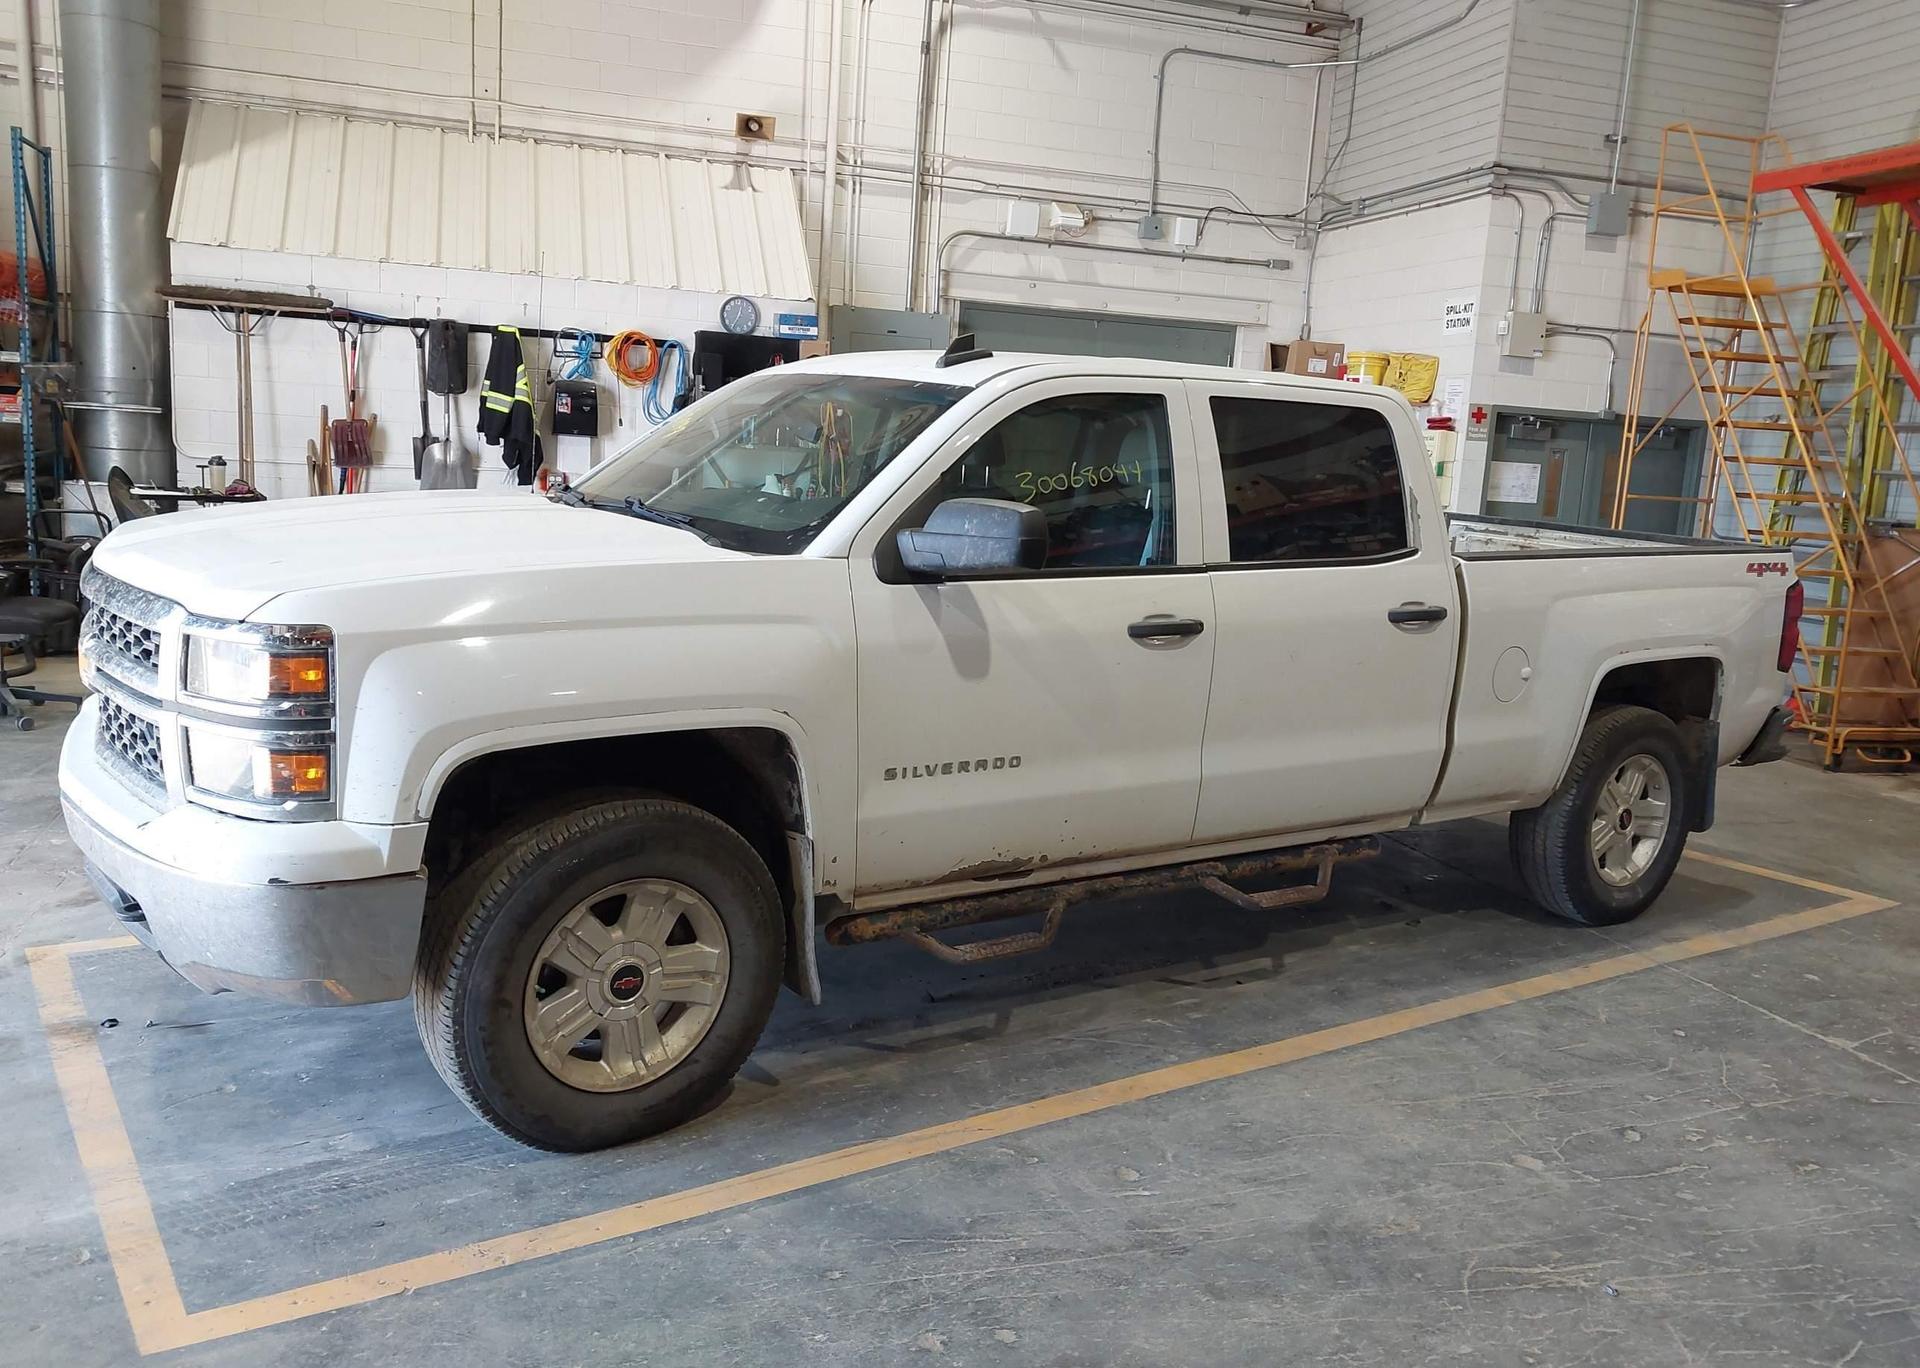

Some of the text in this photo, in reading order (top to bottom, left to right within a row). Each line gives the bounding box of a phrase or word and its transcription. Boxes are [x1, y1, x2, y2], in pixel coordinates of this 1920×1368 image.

[1446, 303, 1474, 315] SPILL-KIT
[1446, 317, 1471, 329] STATION
[883, 755, 1022, 781] SILVERADO
